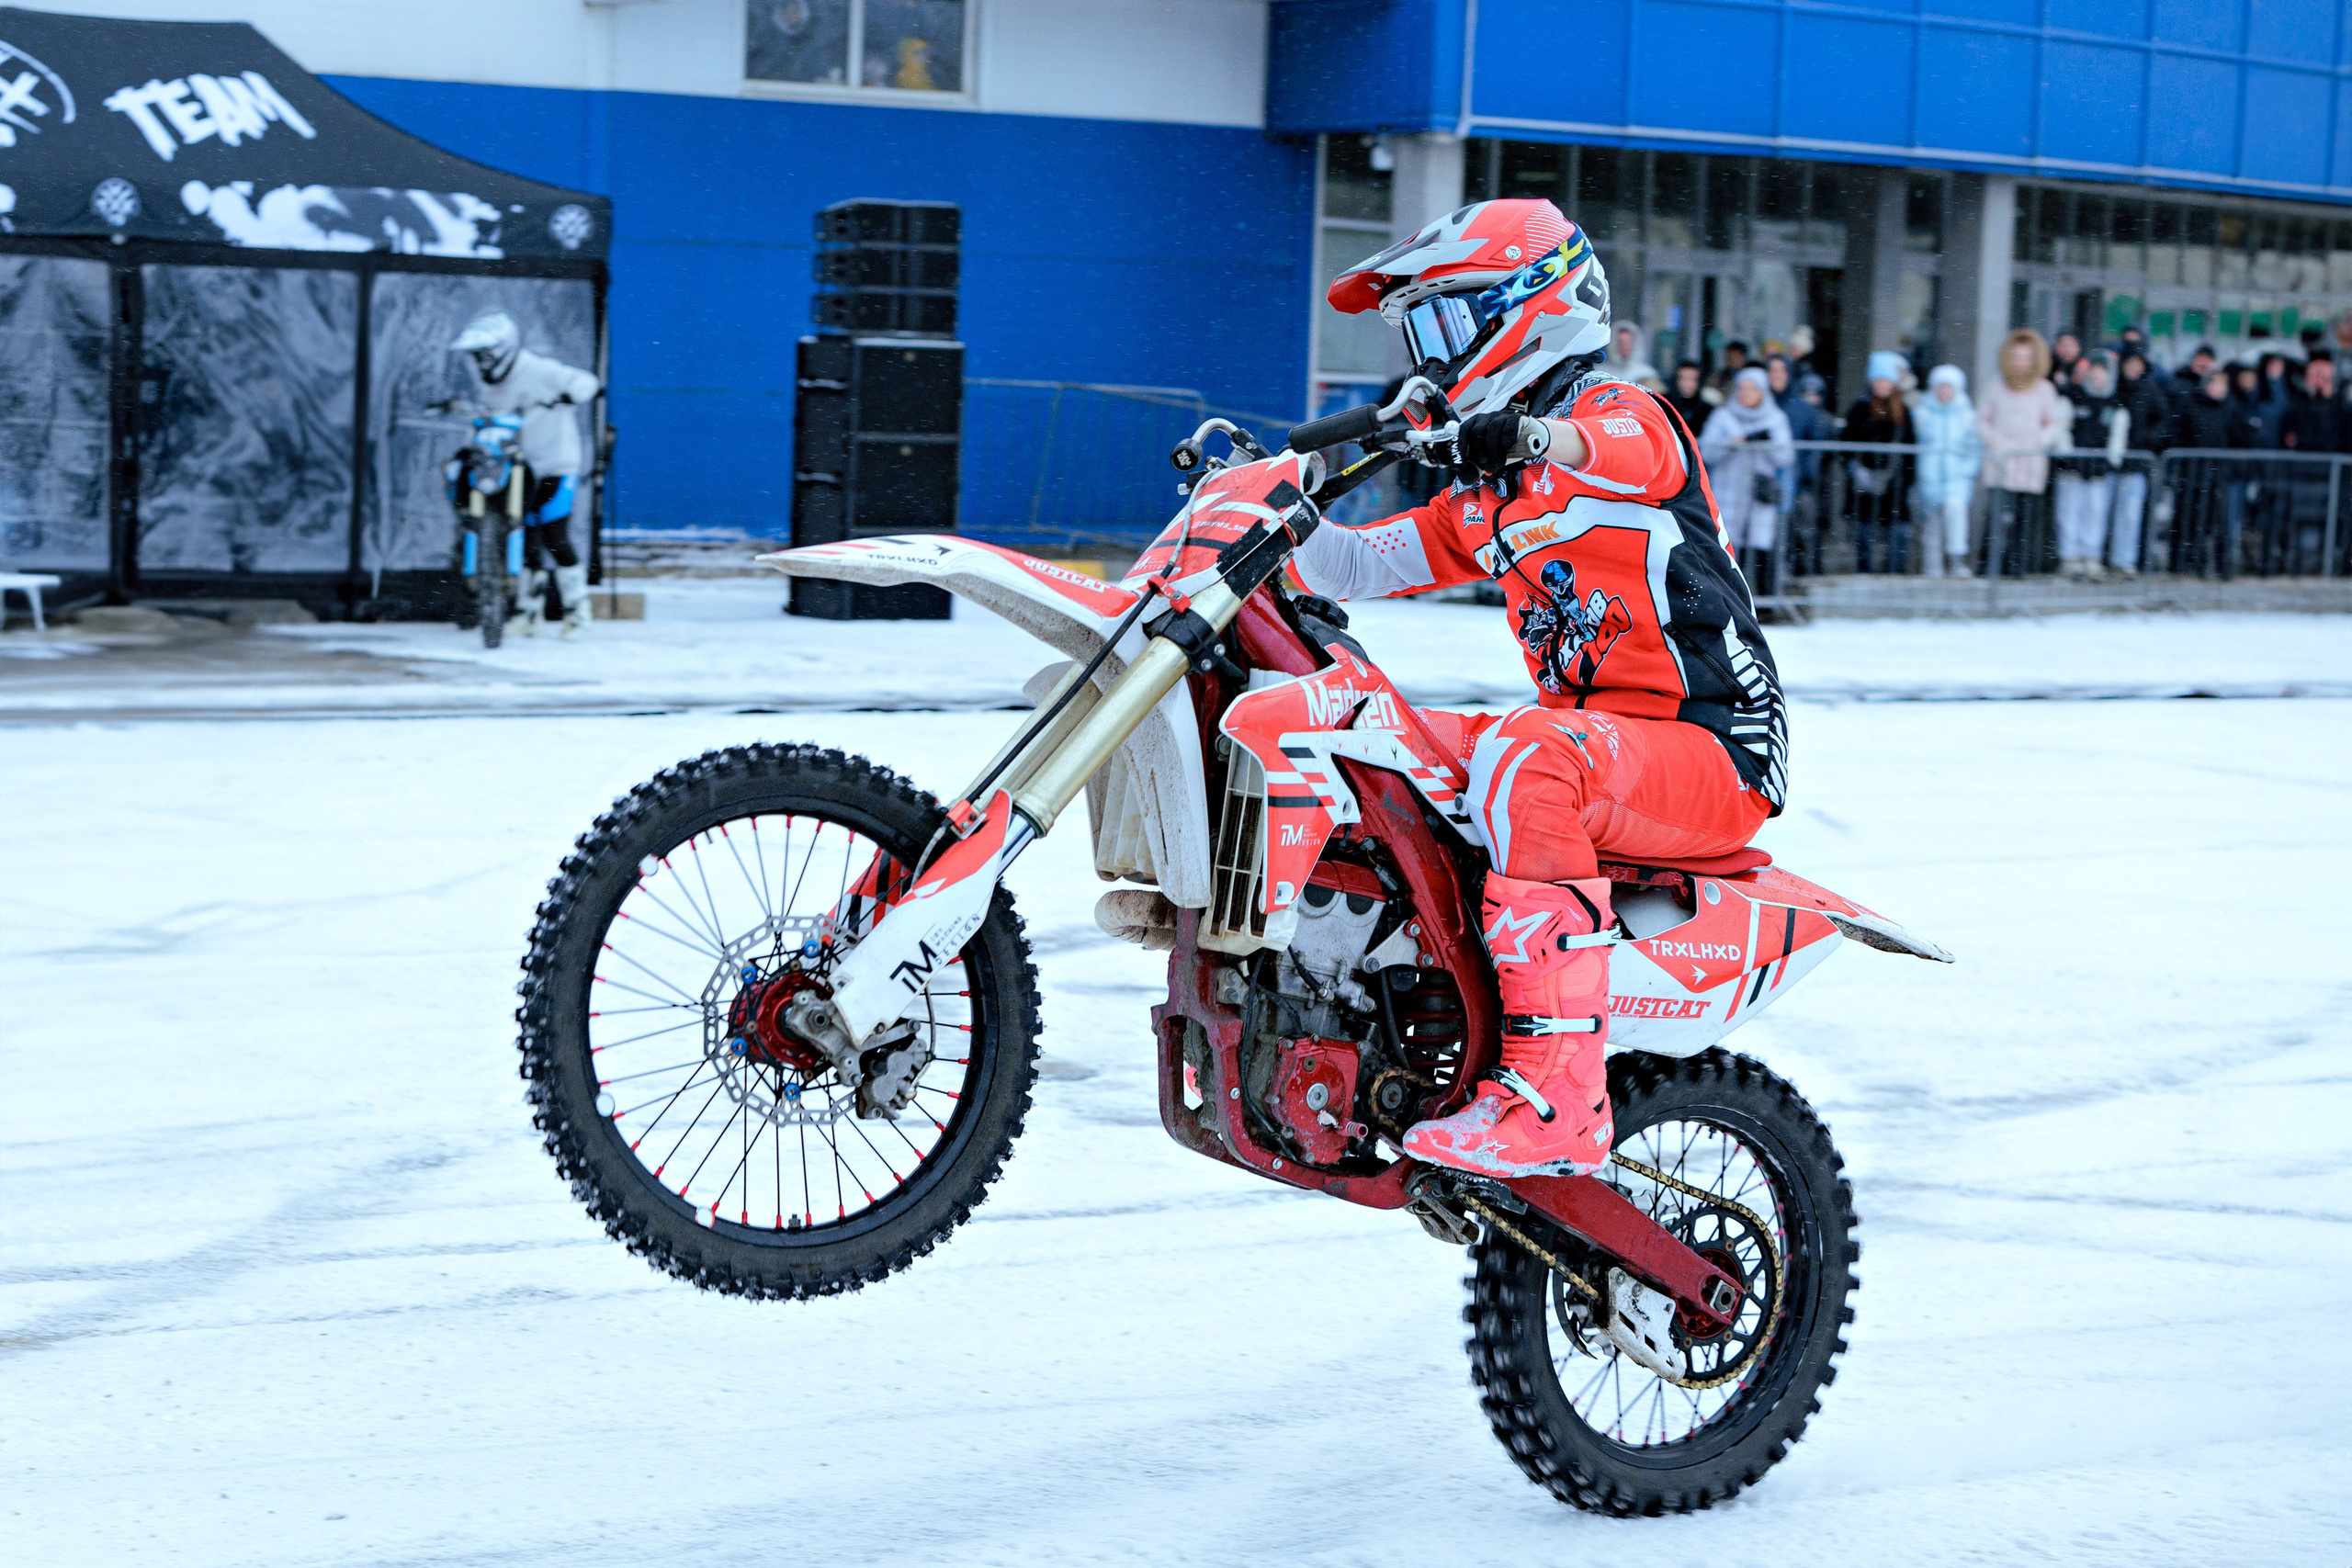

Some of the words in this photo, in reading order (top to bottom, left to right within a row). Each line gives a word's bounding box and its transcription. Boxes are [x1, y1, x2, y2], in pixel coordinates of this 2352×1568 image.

[103, 71, 317, 162] TEAM
[1510, 521, 1561, 552] LINK
[1649, 939, 1741, 961] TRXLHXD
[1608, 995, 1712, 1019] JUSTCAT
